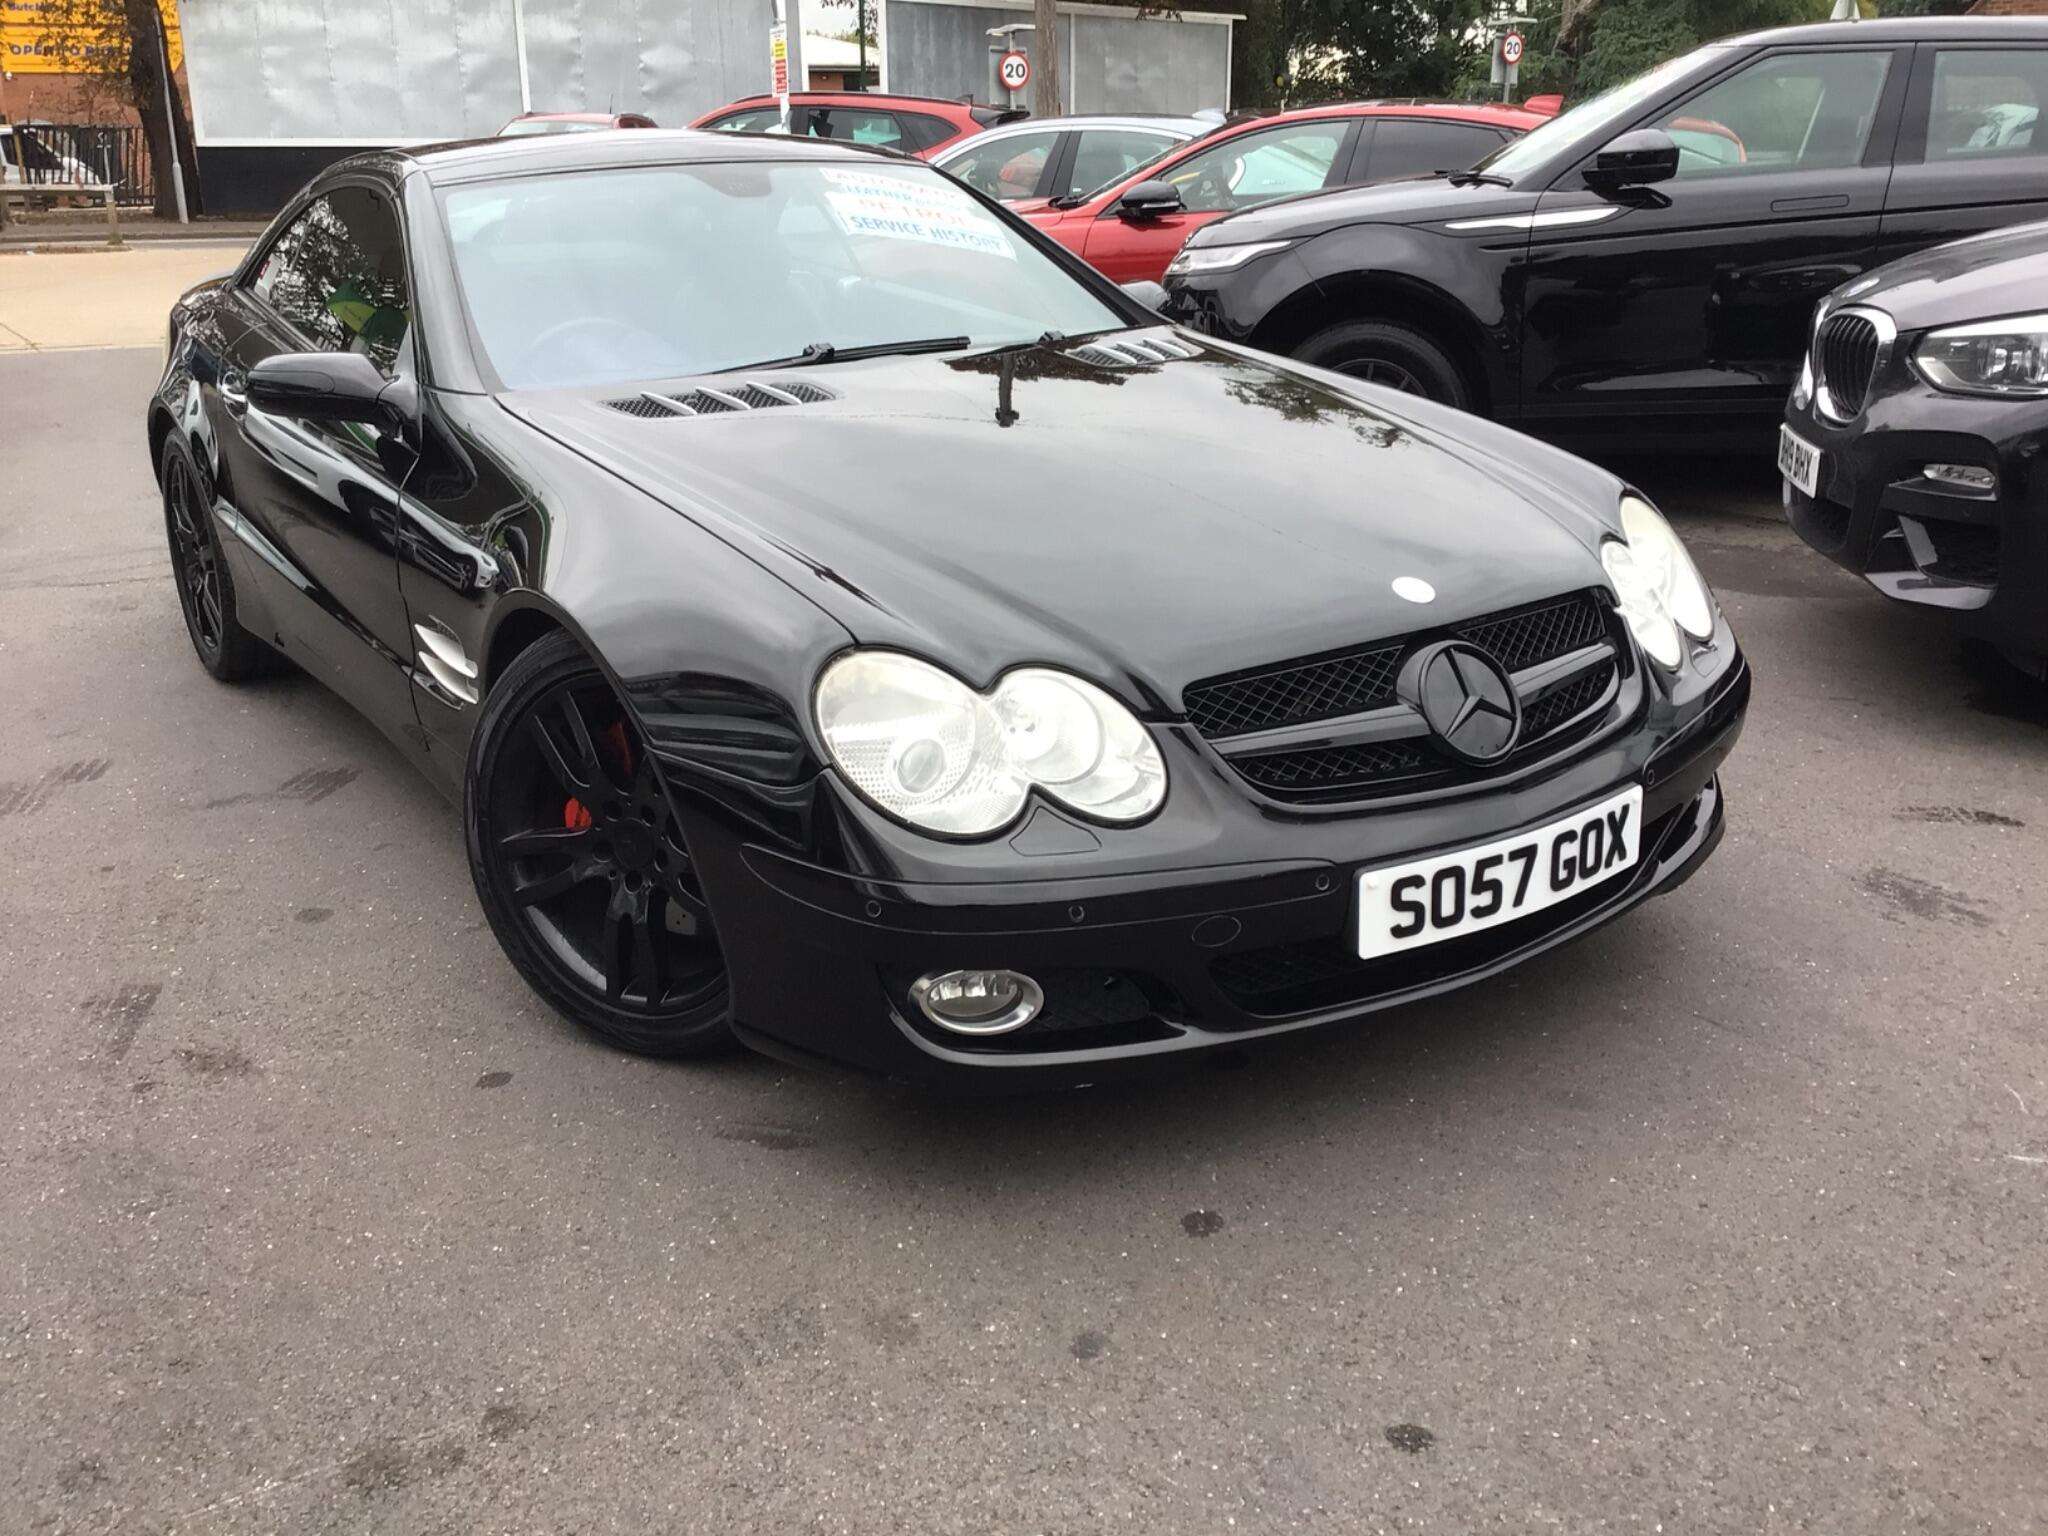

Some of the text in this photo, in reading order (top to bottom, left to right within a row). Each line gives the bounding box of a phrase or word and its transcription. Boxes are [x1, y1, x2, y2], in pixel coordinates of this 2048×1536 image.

[1506, 42, 1521, 55] 20
[1004, 63, 1026, 80] 20
[849, 216, 1003, 251] SERVICE HISTORY
[1388, 803, 1630, 939] SO57 GOX
